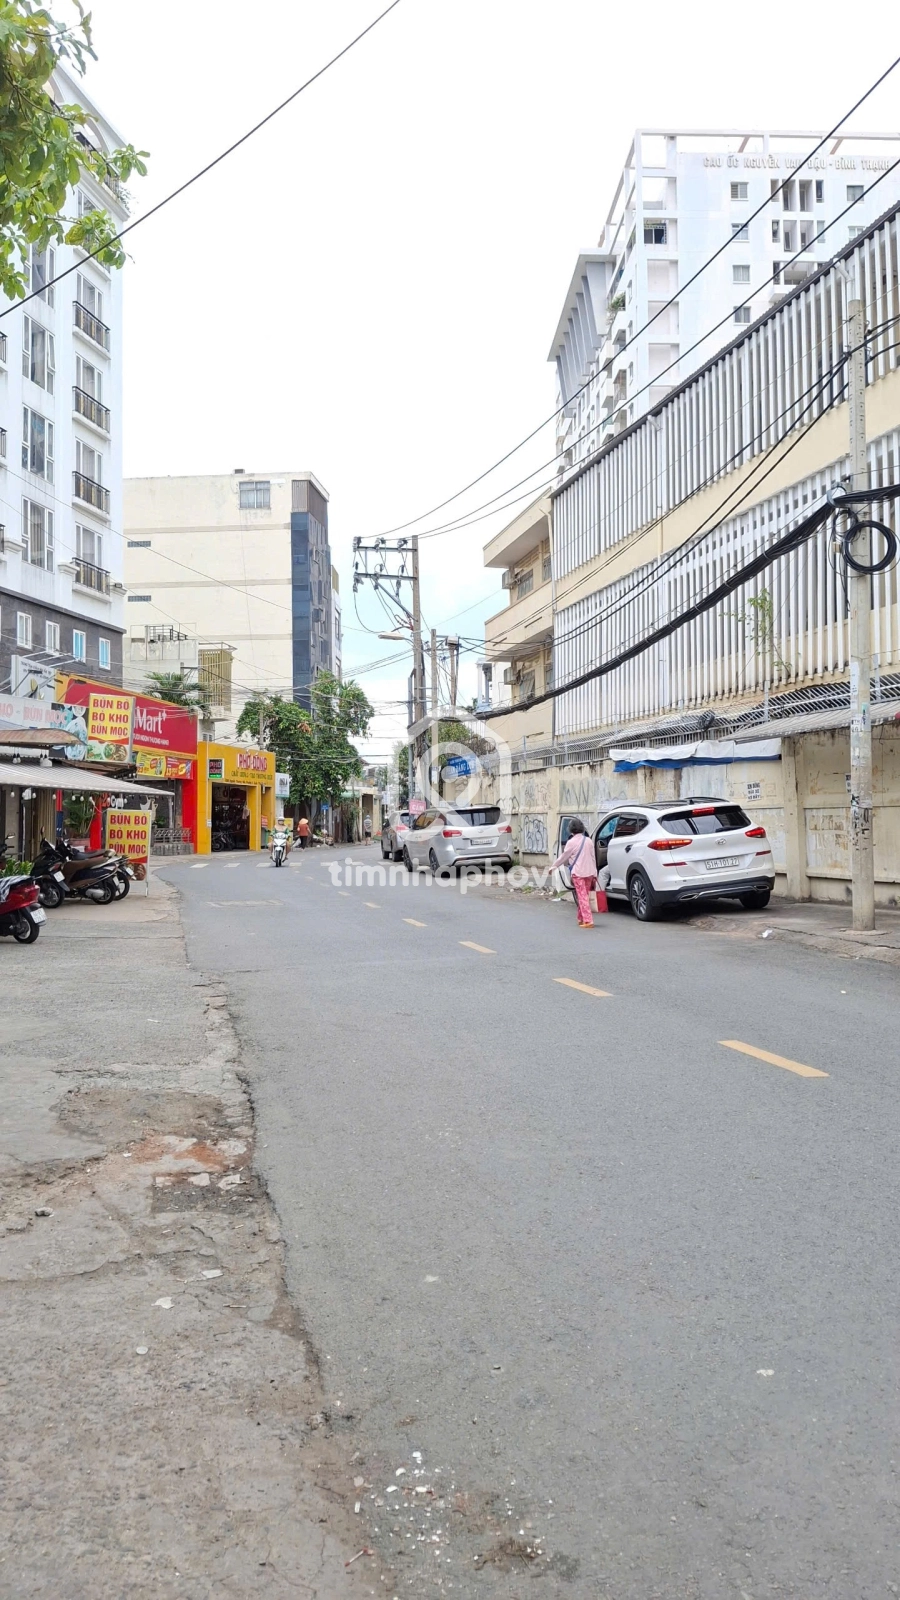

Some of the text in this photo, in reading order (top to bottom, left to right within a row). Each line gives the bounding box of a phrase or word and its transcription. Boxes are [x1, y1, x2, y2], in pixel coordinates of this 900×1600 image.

[703, 157, 722, 168] CAO
[92, 697, 114, 709] BÚN
[108, 713, 129, 724] KHO
[90, 723, 128, 738] BÚN MỌC
[109, 812, 131, 826] BÚN
[126, 829, 147, 840] KHO
[108, 841, 146, 856] BÚN MỌC
